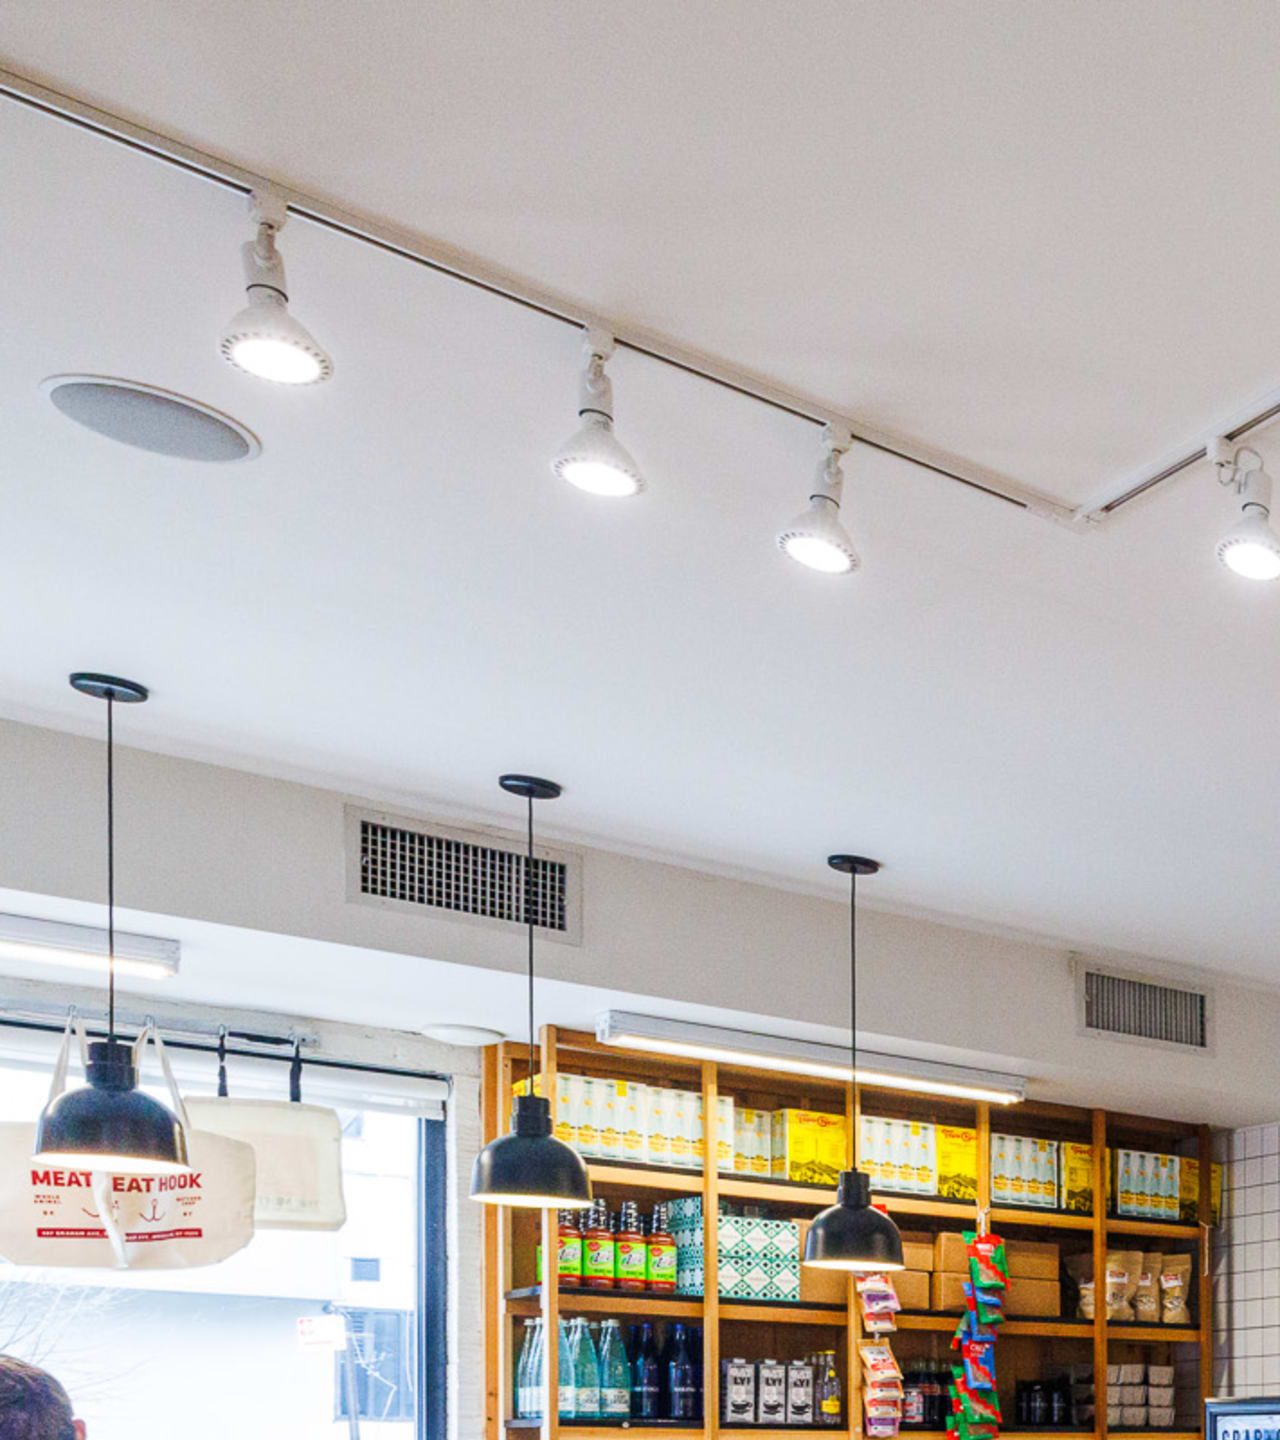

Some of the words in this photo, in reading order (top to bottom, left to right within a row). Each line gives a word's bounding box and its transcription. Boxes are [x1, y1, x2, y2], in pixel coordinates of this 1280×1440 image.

[31, 1170, 93, 1188] MEAT
[112, 1176, 154, 1193] EAT
[158, 1172, 203, 1193] HOOK
